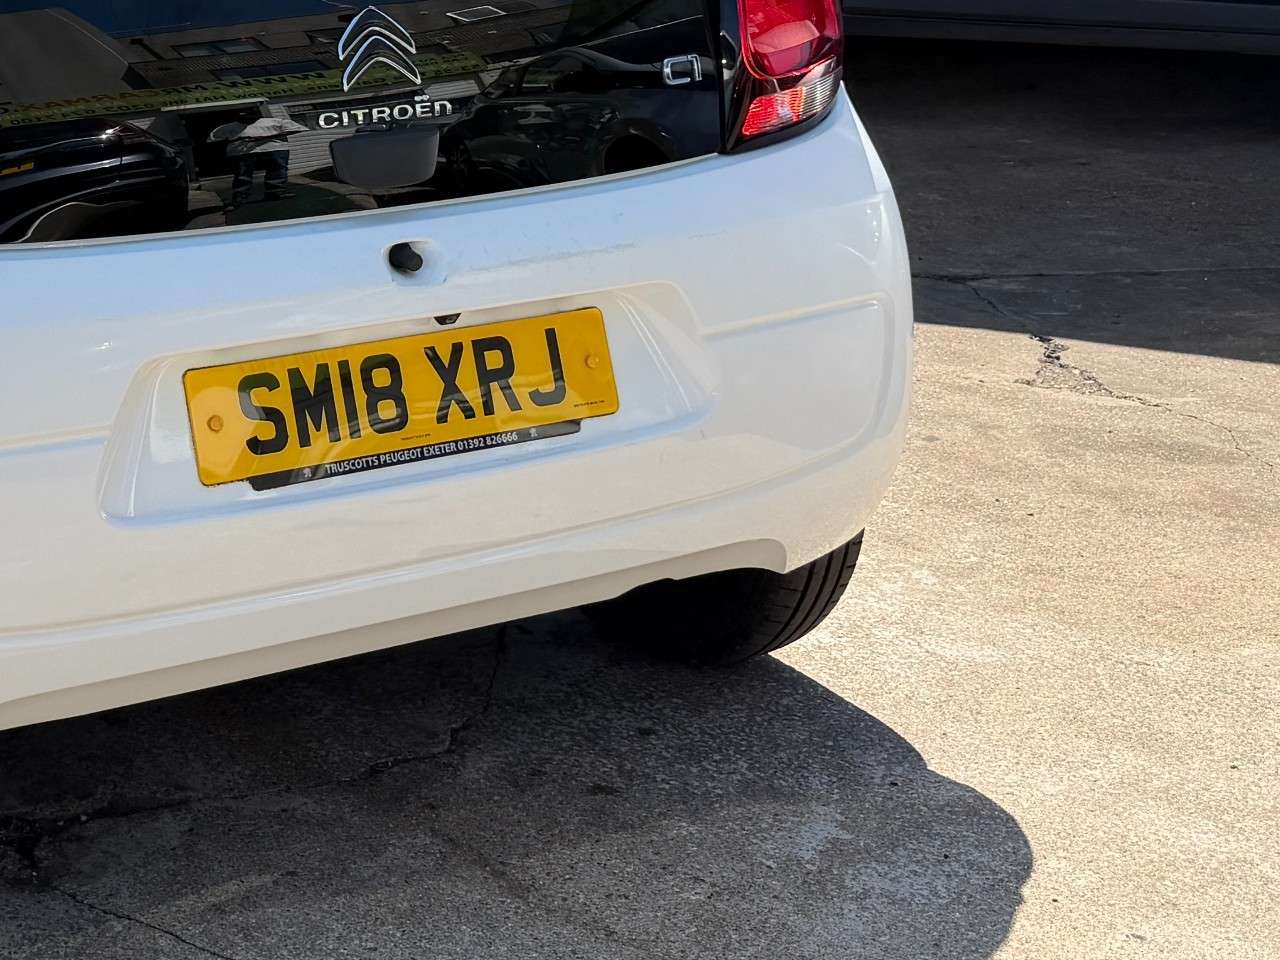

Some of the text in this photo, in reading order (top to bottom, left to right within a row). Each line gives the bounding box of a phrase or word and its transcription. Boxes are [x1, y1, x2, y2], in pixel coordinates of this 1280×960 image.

[662, 53, 703, 86] C1
[318, 94, 453, 129] CITROËN
[237, 327, 568, 456] SM18 XRJ
[325, 431, 518, 474] TRUSCOTTS PEUGEOT EXETER 01392 826666
